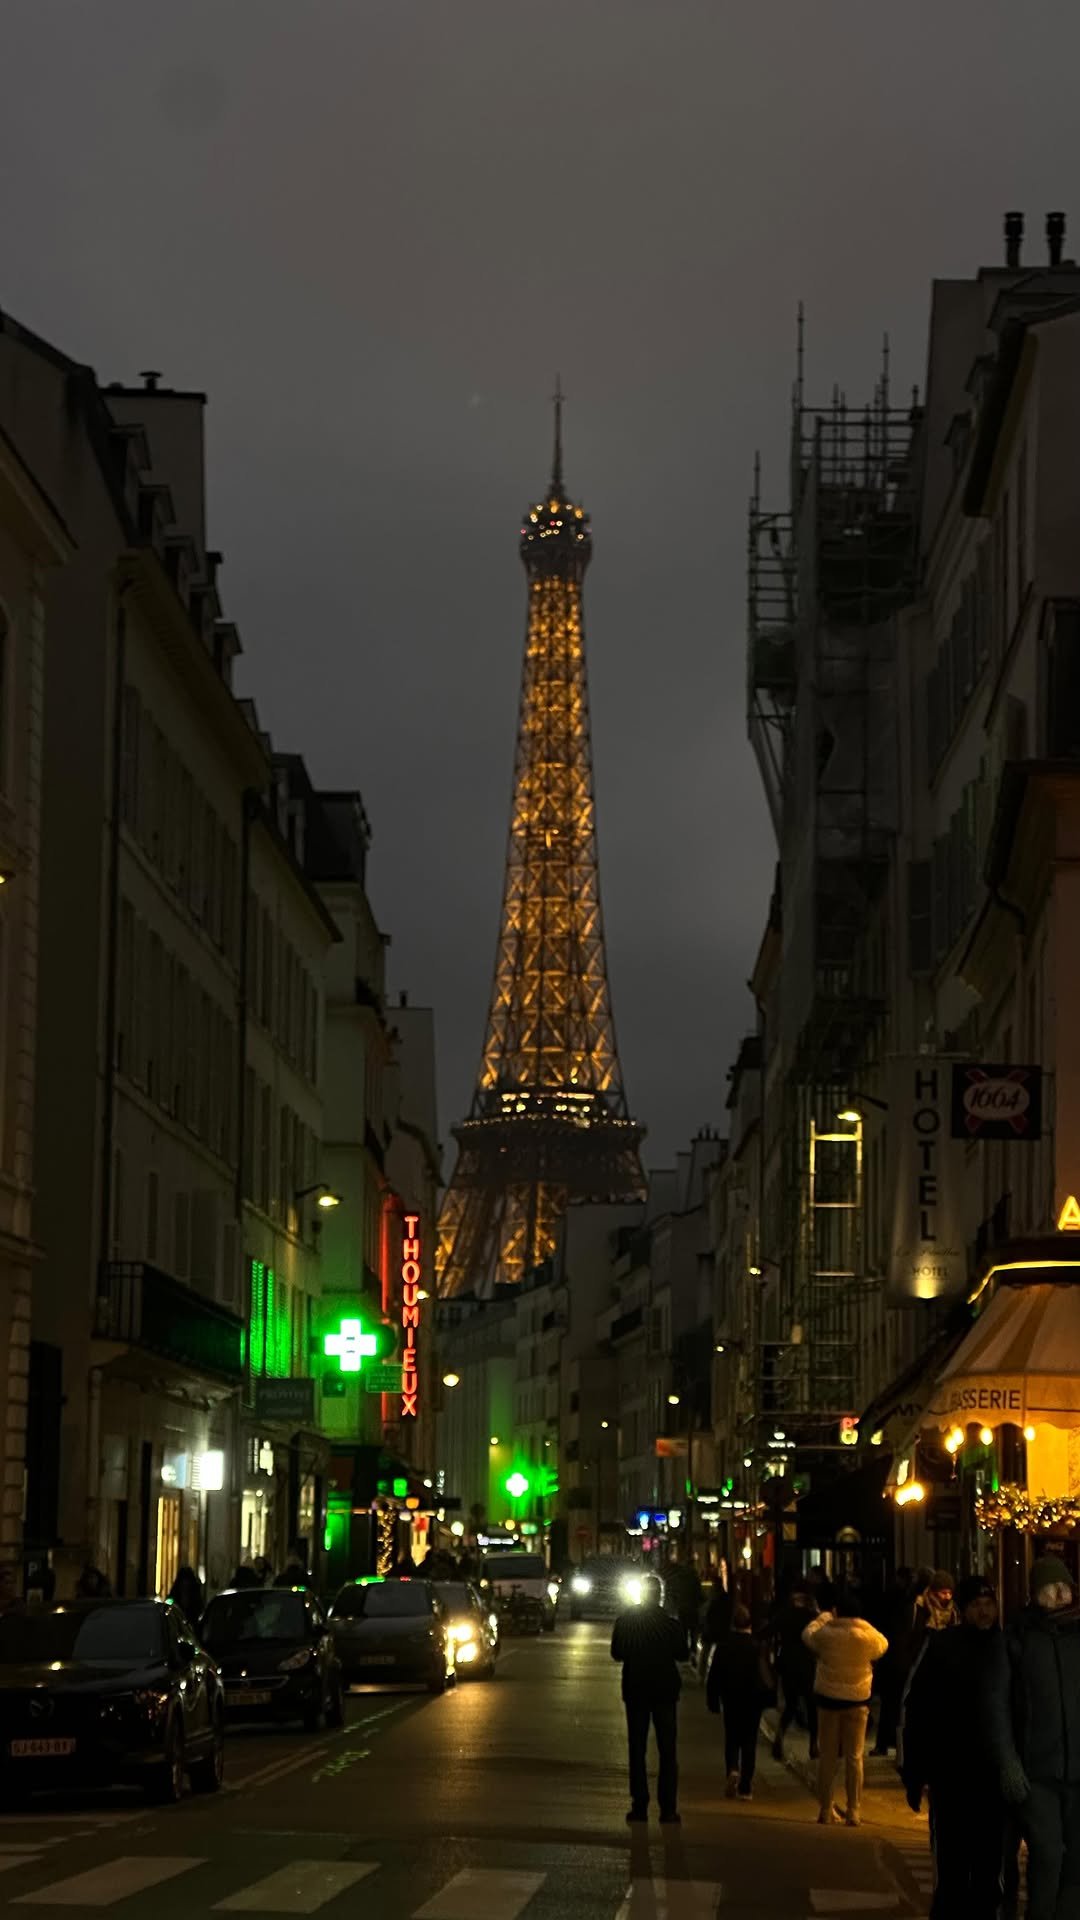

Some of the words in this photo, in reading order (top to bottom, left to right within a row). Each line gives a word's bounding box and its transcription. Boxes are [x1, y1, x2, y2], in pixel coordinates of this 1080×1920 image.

[914, 1069, 940, 1241] HOTEL
[971, 1087, 1020, 1111] 1664
[402, 1215, 421, 1417] THOUMIEUX
